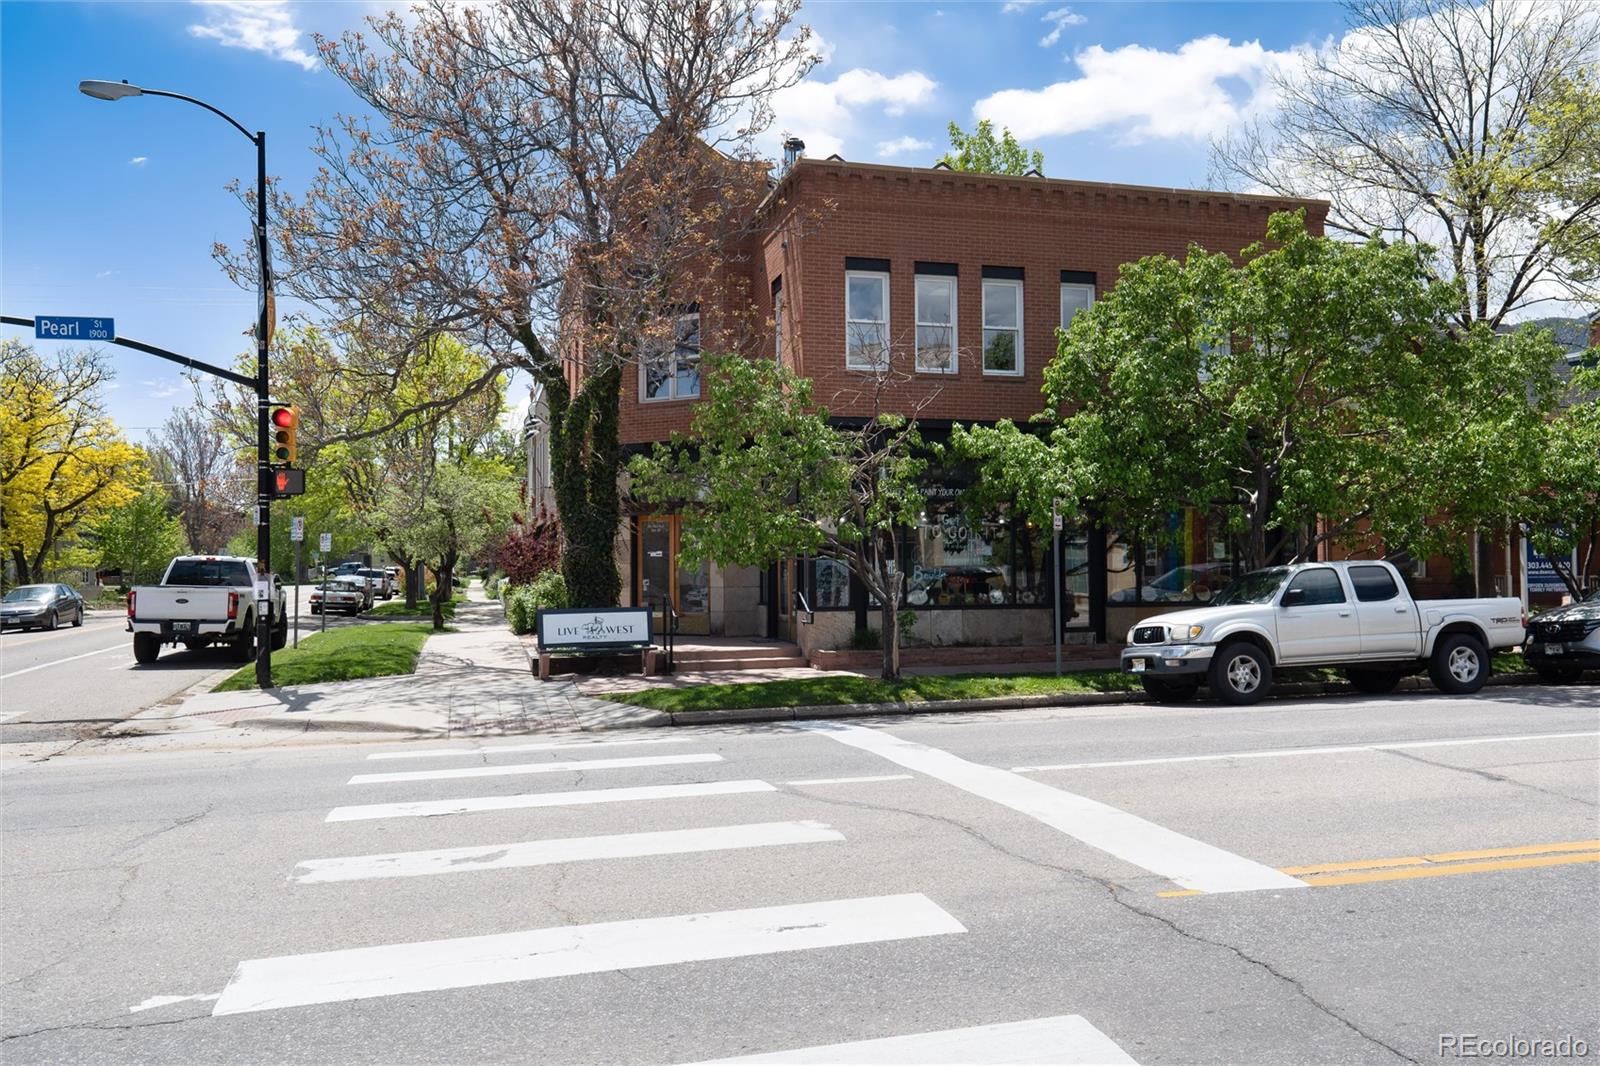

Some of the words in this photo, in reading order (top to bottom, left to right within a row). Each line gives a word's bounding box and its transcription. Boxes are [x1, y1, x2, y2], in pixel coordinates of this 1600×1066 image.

[41, 320, 79, 336] Pearl
[94, 320, 103, 328] St
[89, 329, 107, 338] 1900
[937, 488, 954, 497] YOUR
[949, 526, 968, 540] GO
[557, 627, 579, 637] LIVE
[605, 625, 634, 634] WEST
